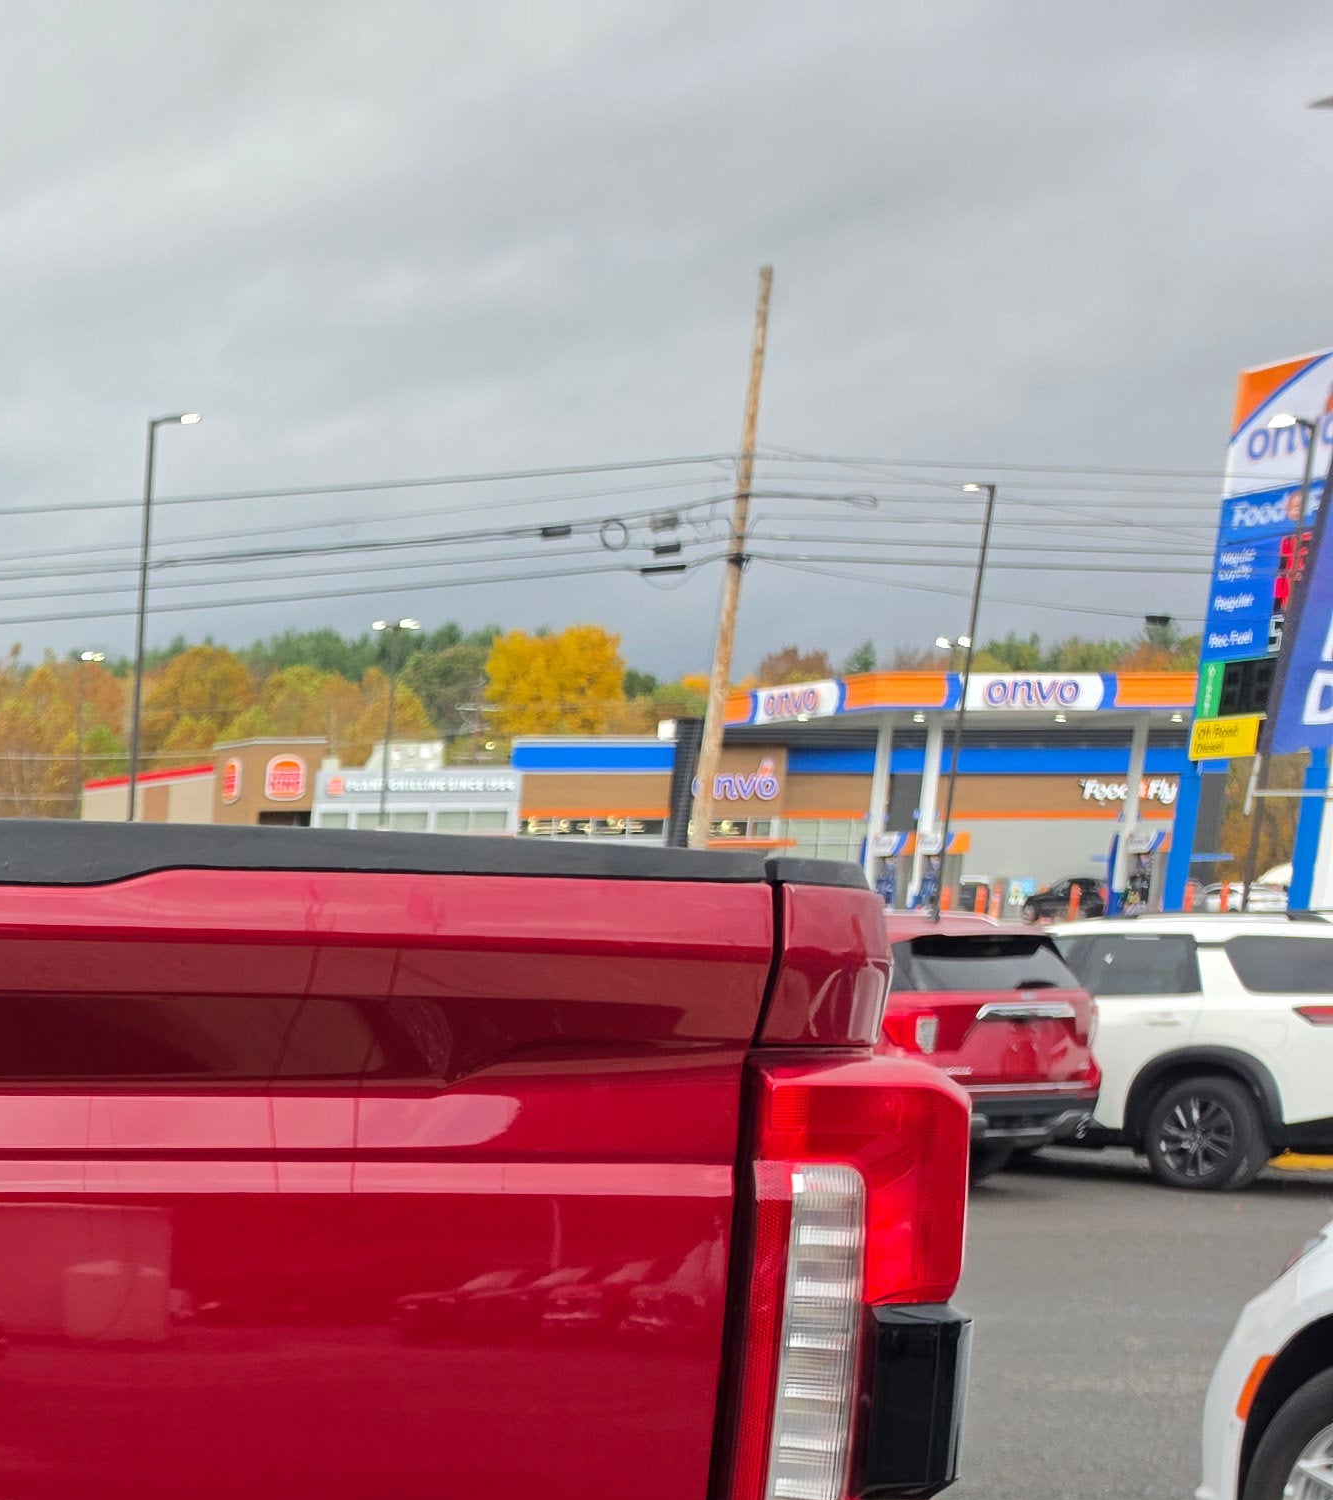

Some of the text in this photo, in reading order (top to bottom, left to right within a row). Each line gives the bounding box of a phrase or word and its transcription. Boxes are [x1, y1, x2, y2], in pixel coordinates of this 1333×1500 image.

[763, 686, 820, 719] onvo
[984, 677, 1082, 708] onvo
[691, 773, 780, 800] nvo
[1148, 778, 1178, 804] Fly
